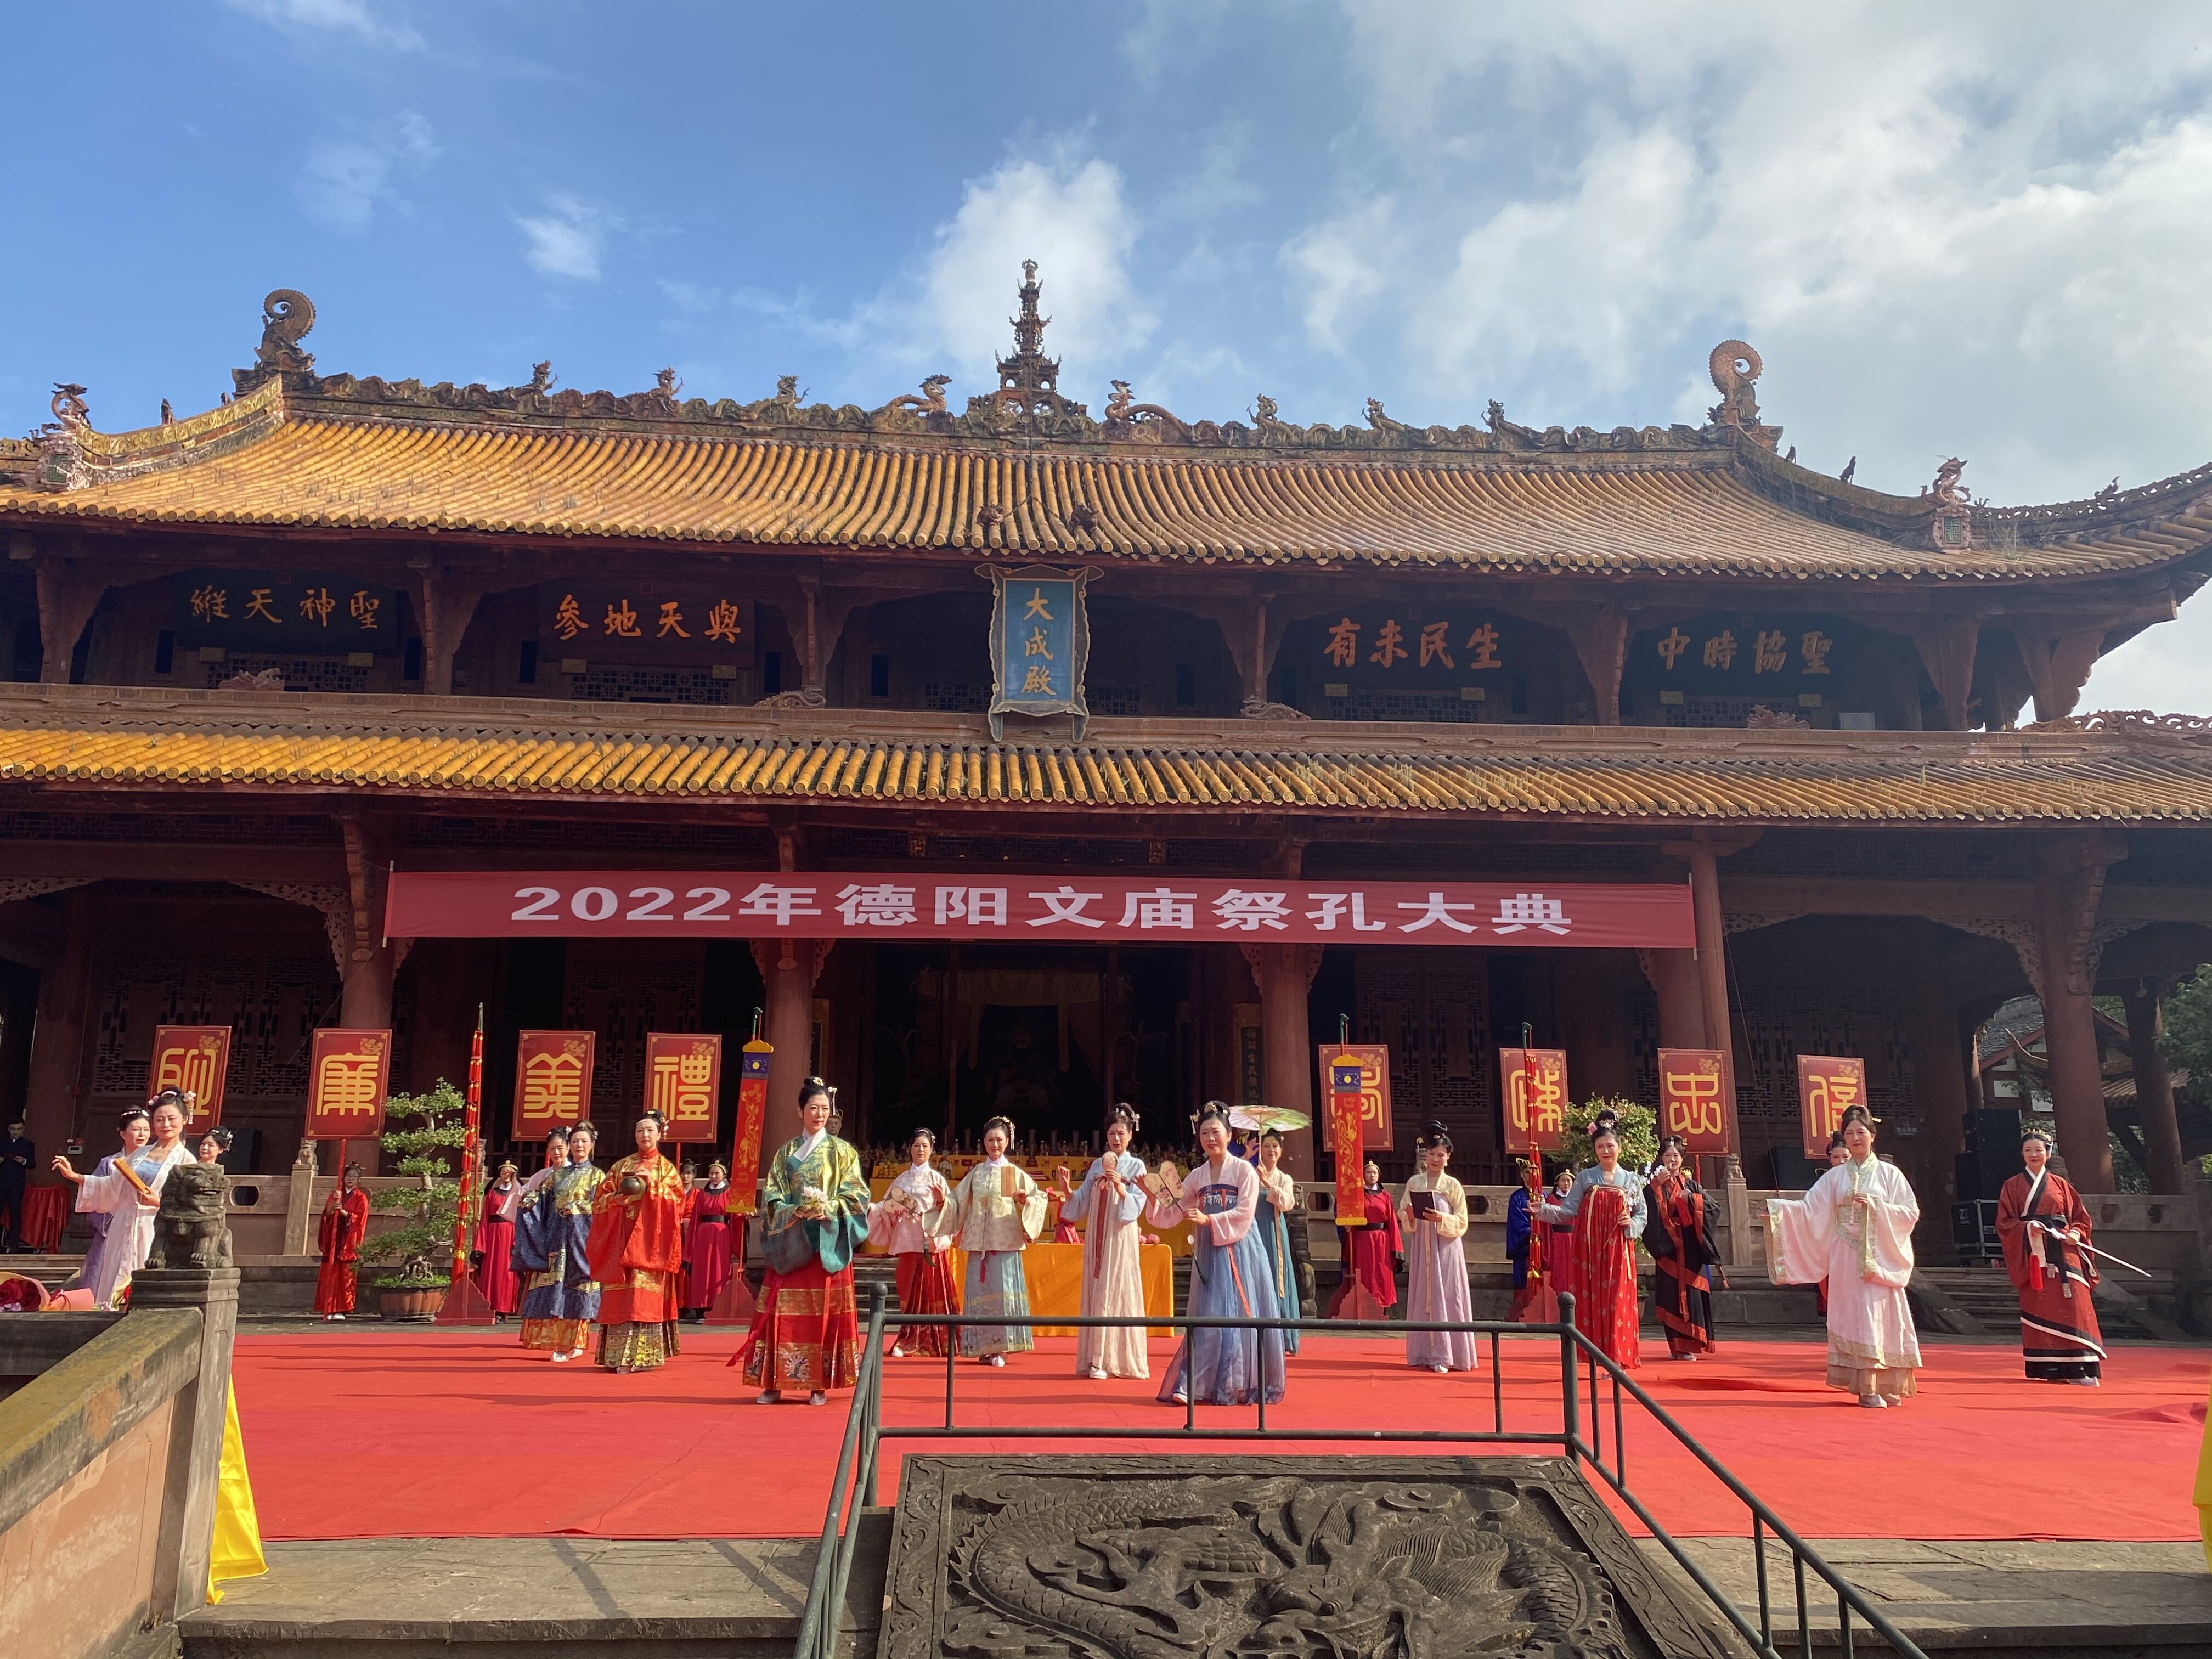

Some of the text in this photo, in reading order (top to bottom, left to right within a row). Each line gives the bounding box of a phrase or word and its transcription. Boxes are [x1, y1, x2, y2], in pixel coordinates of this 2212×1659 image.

[1021, 588, 1057, 696] 大成殿
[511, 884, 1572, 935] 2022年德阳文庙祭孔大典
